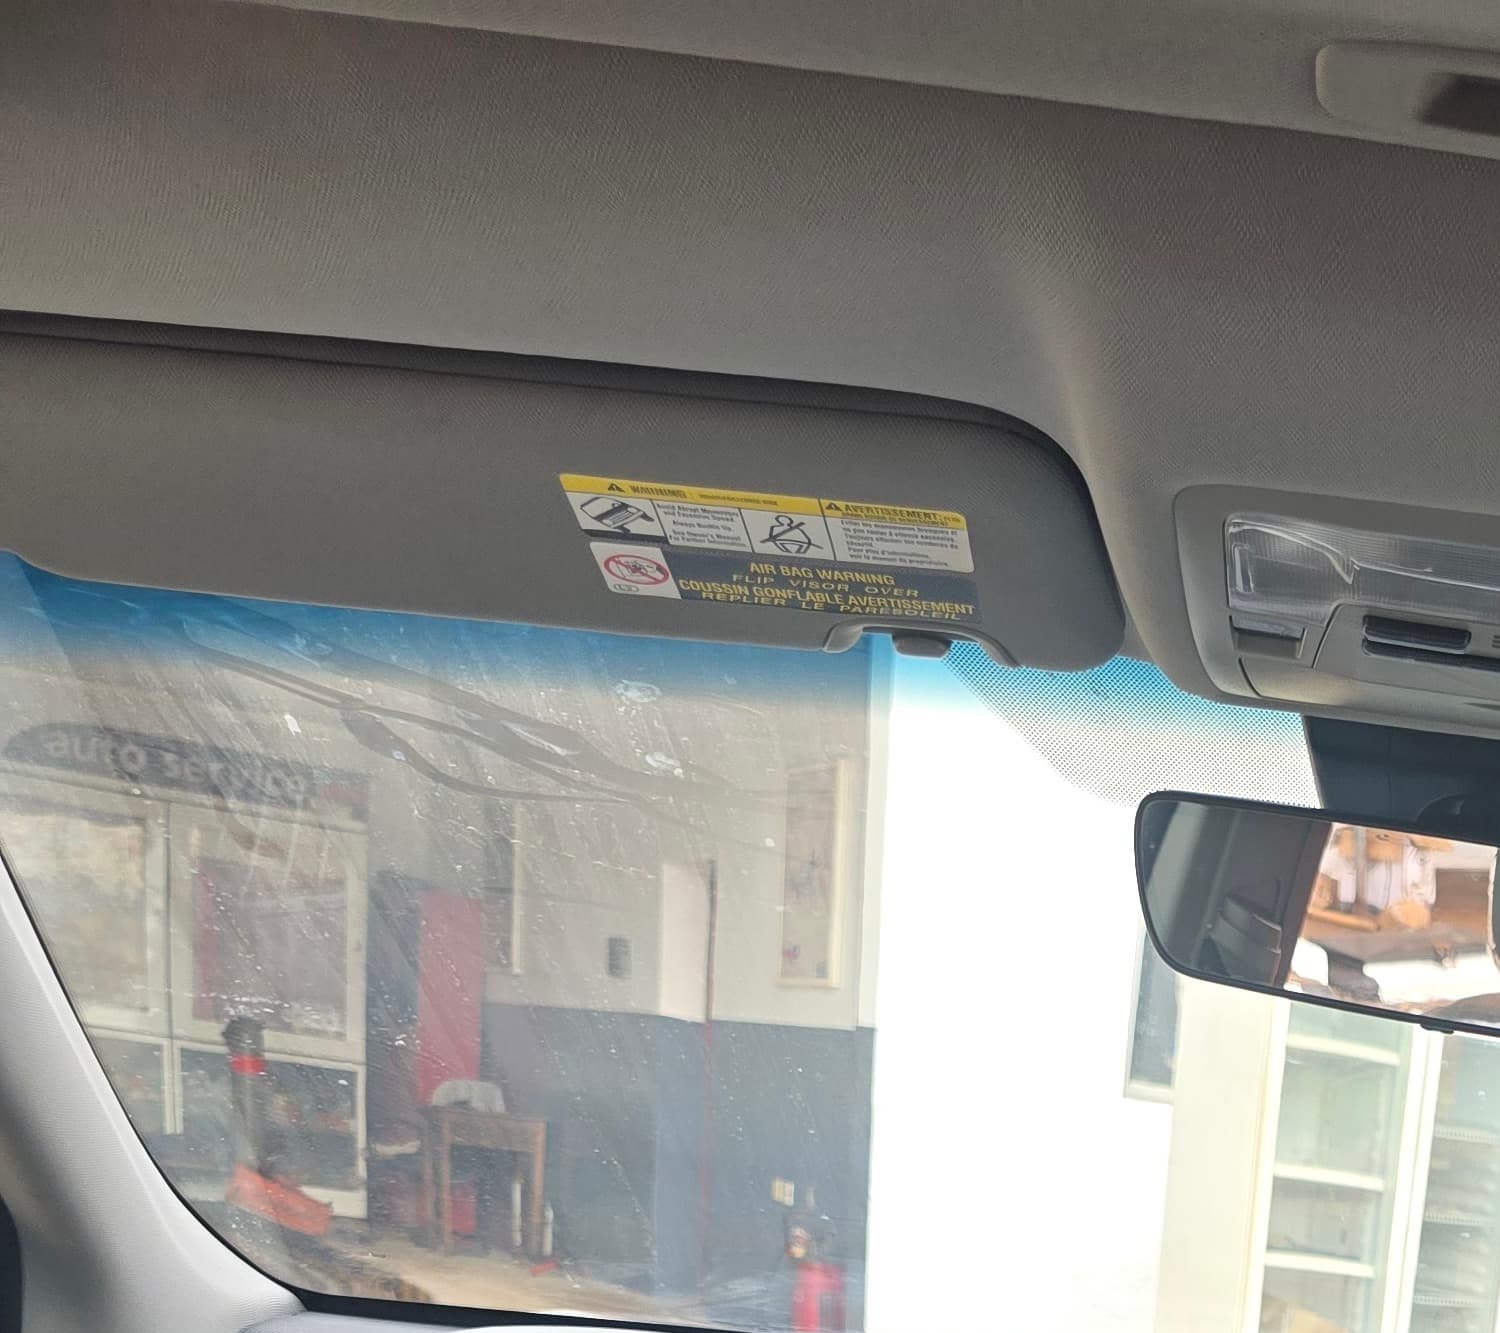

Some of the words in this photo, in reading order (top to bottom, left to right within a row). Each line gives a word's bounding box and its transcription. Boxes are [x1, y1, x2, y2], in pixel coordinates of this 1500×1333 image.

[750, 562, 776, 575] AIR
[779, 565, 813, 578] BAG
[815, 568, 896, 585] WARNING
[679, 579, 750, 596] COUSSIN
[753, 586, 845, 605] GONFLABLE
[848, 595, 976, 615] AVERTISSEMENT
[732, 574, 775, 584] FLIP
[789, 579, 849, 591] VISOR
[865, 586, 919, 598] OVER
[702, 592, 787, 606] REPLIER
[801, 602, 825, 610] LE
[41, 728, 150, 775] auto
